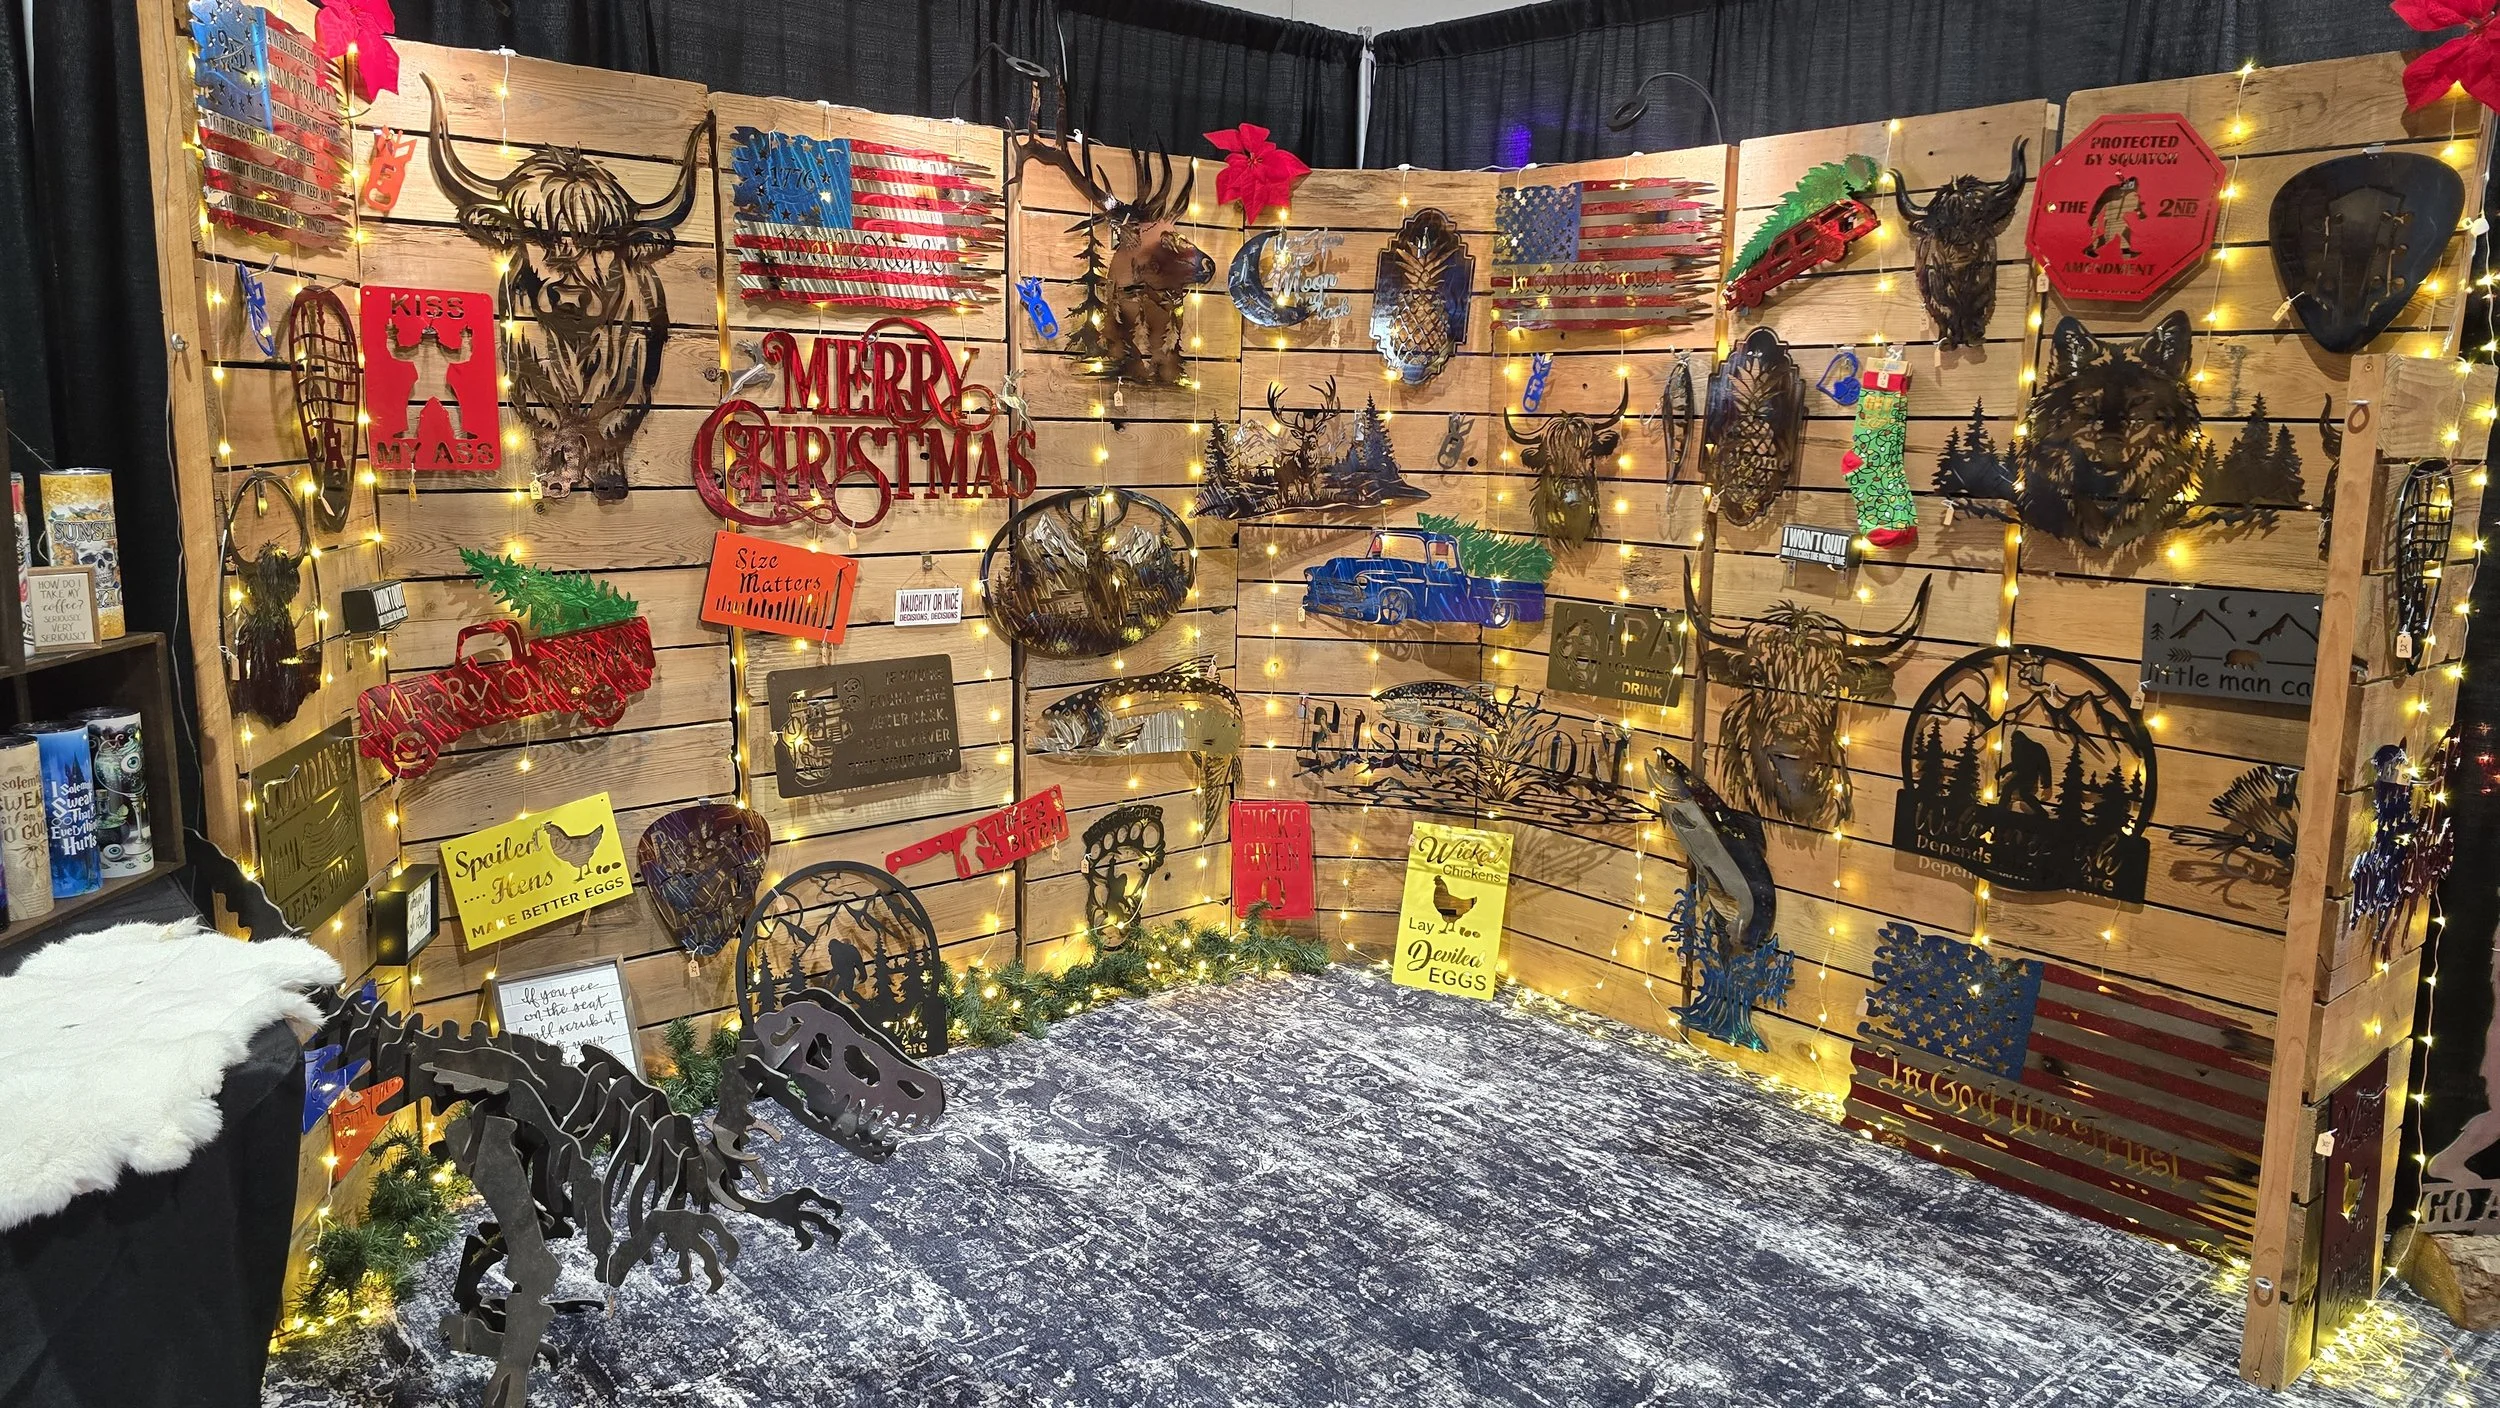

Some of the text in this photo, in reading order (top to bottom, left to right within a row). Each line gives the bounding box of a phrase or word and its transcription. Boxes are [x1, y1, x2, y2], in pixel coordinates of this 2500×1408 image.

[272, 102, 294, 125] MILITIA
[220, 115, 235, 135] THE
[236, 121, 270, 149] SECURITY
[2090, 135, 2180, 150] PROTECTED
[2084, 151, 2179, 168] BY SQUATCH
[769, 165, 815, 193] 1776
[2058, 197, 2200, 218] THE 2ND
[2063, 261, 2158, 277] AMENDMENT
[390, 292, 465, 320] KISS
[762, 317, 998, 432] MERRY
[376, 440, 495, 465] MY ASS
[692, 400, 1036, 529] CHRISTMAS
[1782, 527, 1850, 556] I WON'T QUIT
[735, 547, 779, 571] Size
[37, 579, 60, 589] HOW
[63, 578, 76, 588] DO
[40, 588, 81, 600] TAKE MY
[738, 572, 822, 594] Matters
[41, 598, 85, 614] coffee?
[900, 592, 959, 612] NAUGHTY OR NICE
[43, 613, 82, 623] SERIOUSLY
[51, 623, 73, 633] VERY
[900, 611, 958, 622] DECISIONS, DECISIONS
[40, 630, 87, 643] SERIOUSLY
[1606, 613, 1677, 665] IPA
[501, 634, 644, 706] CHRISTMAS
[2147, 662, 2210, 688] little
[2219, 673, 2271, 694] man
[1621, 681, 1663, 699] DRINK
[369, 676, 490, 731] MERRY
[1297, 700, 1630, 793] FISH ON
[52, 781, 58, 798] I
[261, 741, 353, 826] LOADING
[992, 800, 1047, 837] LIFE'S
[1120, 806, 1163, 821] PEOPLE
[1240, 808, 1302, 839] FUCKS
[61, 834, 98, 856] Hurts
[991, 815, 1064, 861] A BITCH
[1915, 834, 1993, 865] Depends
[1244, 842, 1299, 872] GIVEN
[1418, 835, 1505, 868] Wicked
[1442, 864, 1501, 883] Chickens
[283, 873, 326, 926] LEASE
[491, 869, 554, 905] Hens
[471, 875, 625, 939] MAKE BETTER EGGS
[1409, 916, 1435, 936] Lay
[1406, 939, 1487, 972] Deviled
[1429, 967, 1488, 992] EGGS
[521, 982, 600, 1008] If you pee
[524, 992, 609, 1022] on the seat
[558, 1013, 603, 1035] scrub
[604, 1009, 619, 1026] it
[904, 1041, 928, 1056] are
[1876, 1044, 1928, 1098] In
[1930, 1064, 2001, 1127] God
[2071, 1114, 2187, 1188] Trust
[2419, 1188, 2473, 1223] GO
